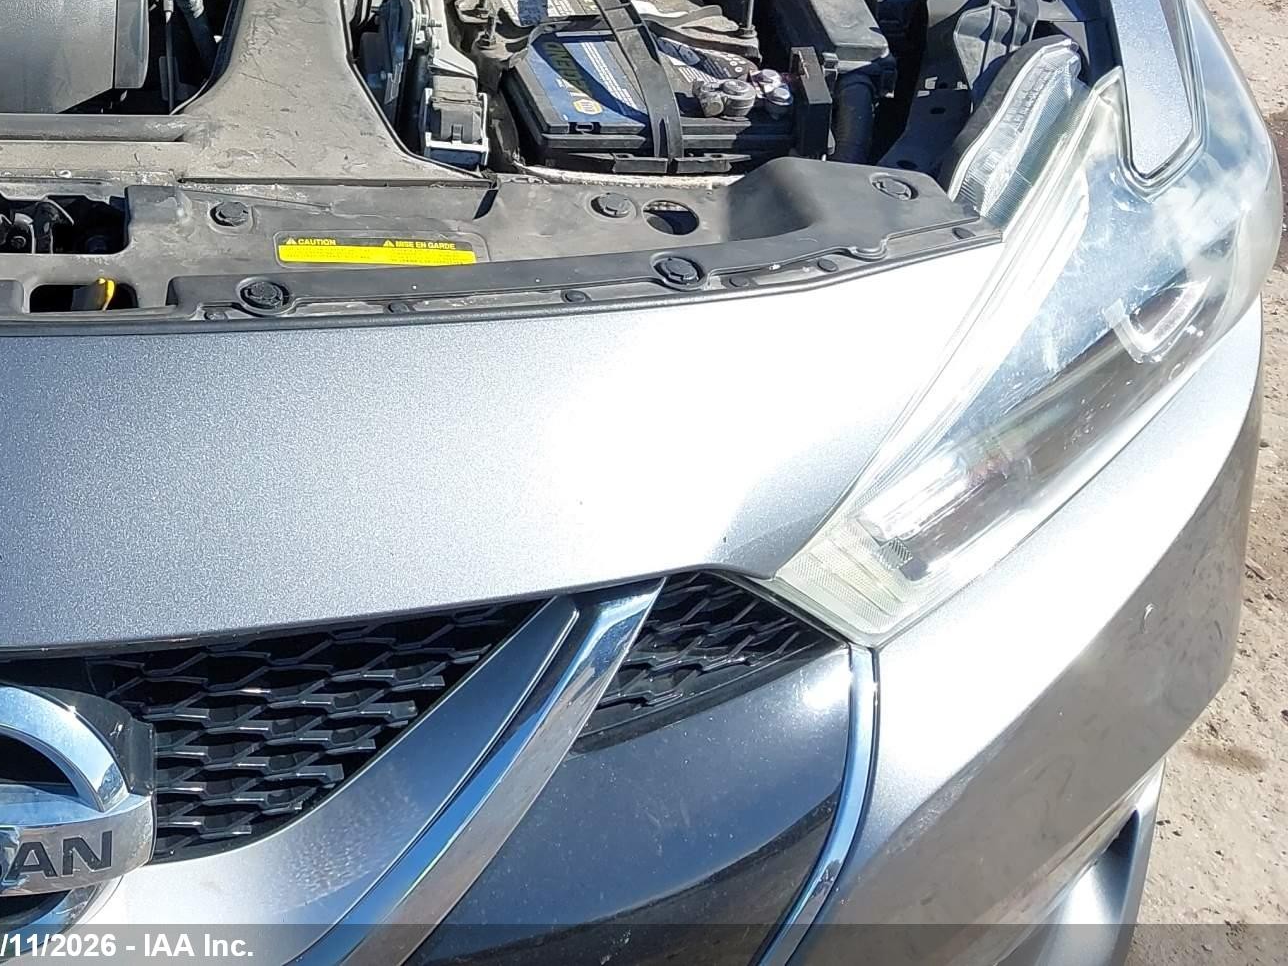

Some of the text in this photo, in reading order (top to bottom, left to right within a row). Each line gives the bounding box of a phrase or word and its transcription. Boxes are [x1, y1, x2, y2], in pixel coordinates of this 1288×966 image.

[297, 238, 336, 246] CAUTION
[395, 240, 414, 248] MISE
[427, 242, 456, 250] GARDE
